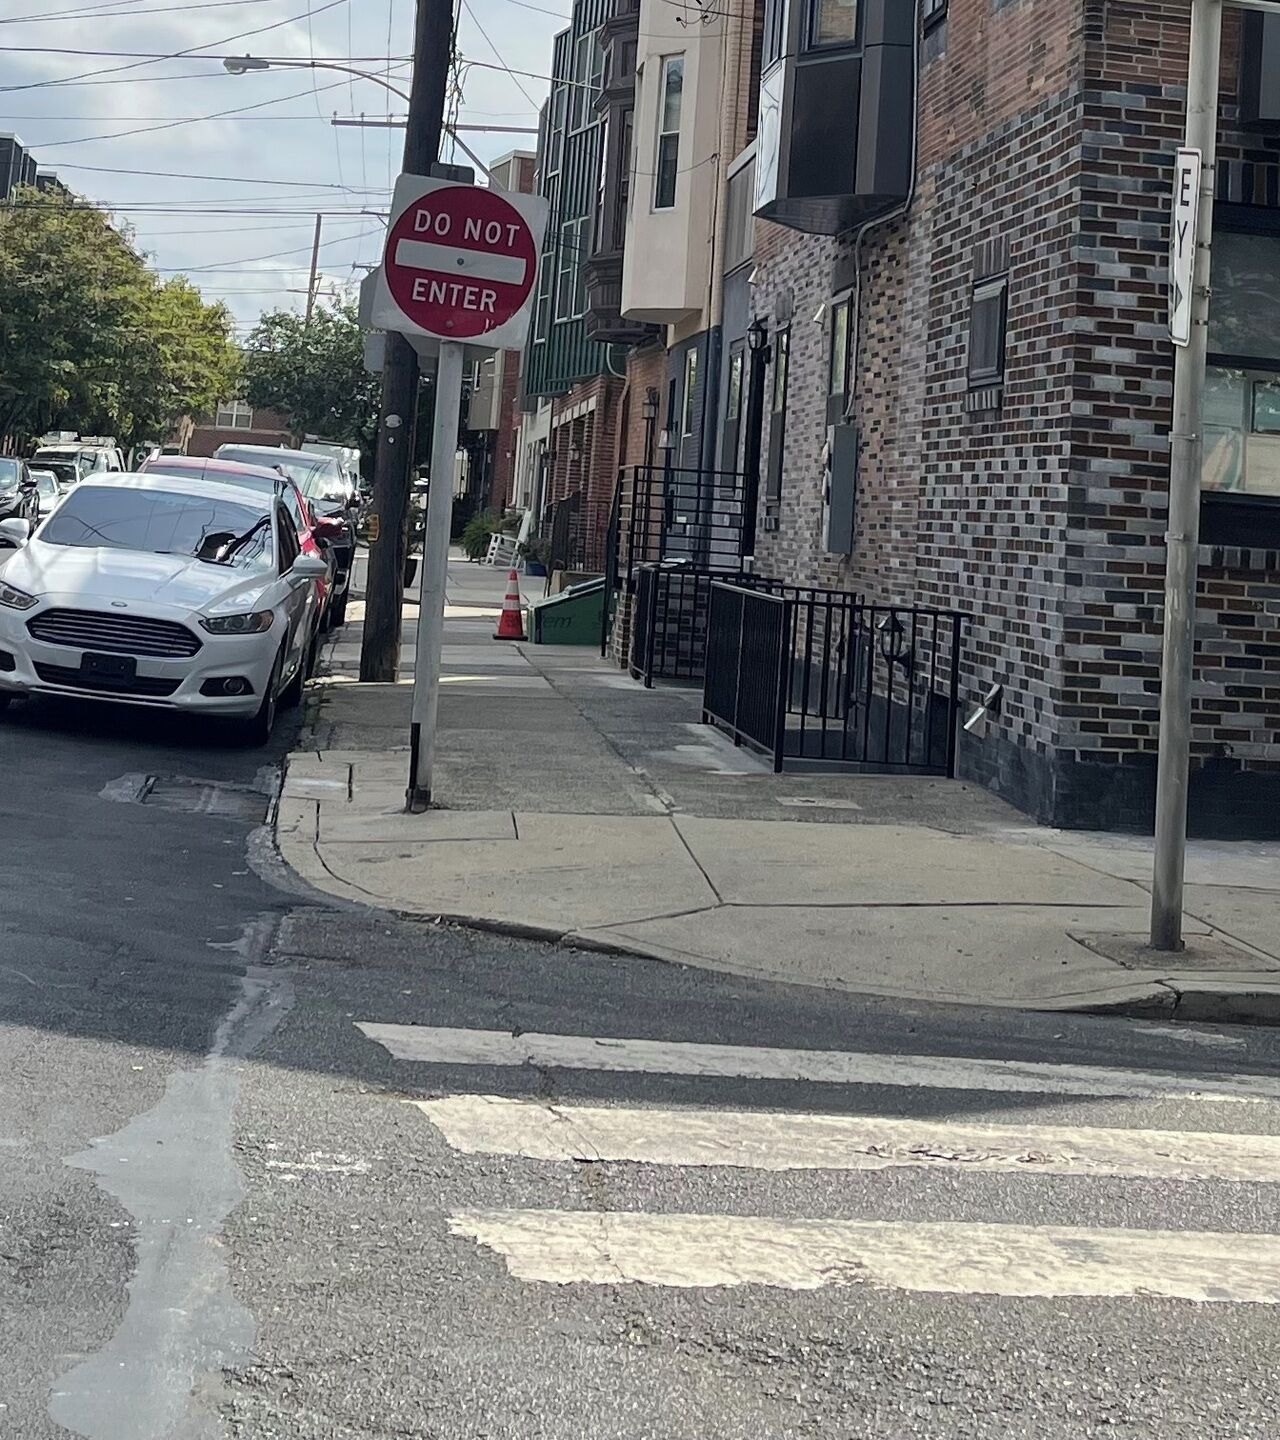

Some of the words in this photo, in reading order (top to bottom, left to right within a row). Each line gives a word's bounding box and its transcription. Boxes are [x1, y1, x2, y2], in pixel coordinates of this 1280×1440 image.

[414, 209, 451, 236] DO
[464, 217, 520, 247] NOT
[412, 278, 497, 313] ENTER
